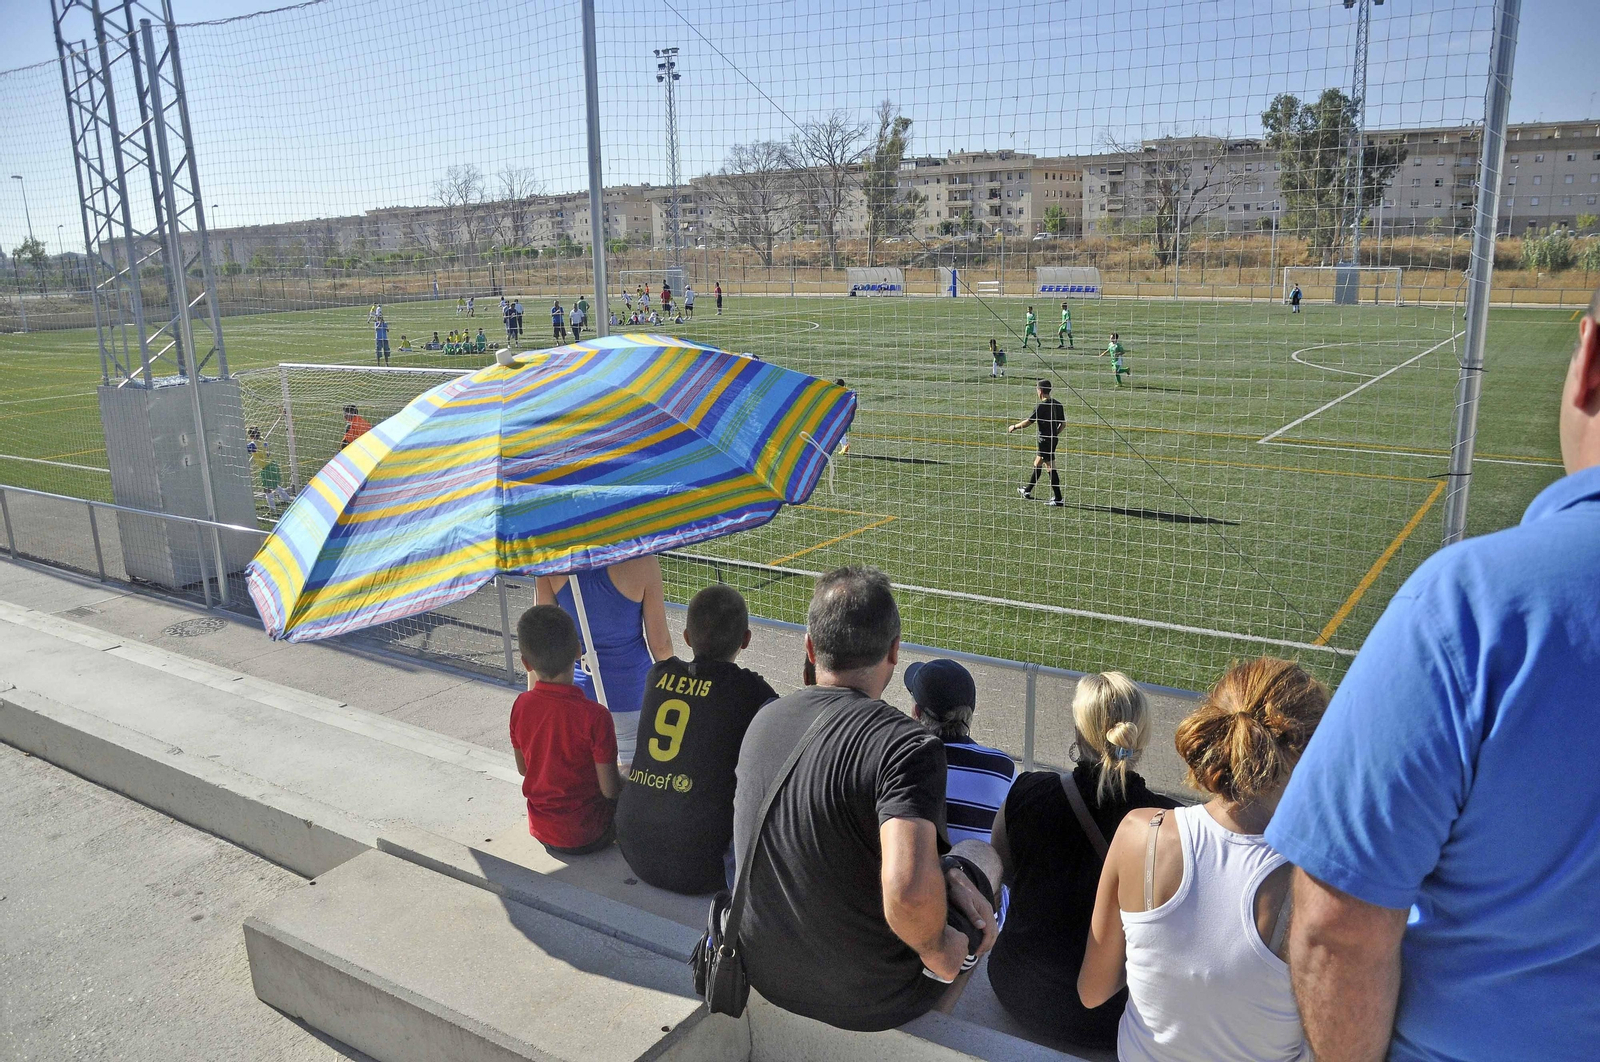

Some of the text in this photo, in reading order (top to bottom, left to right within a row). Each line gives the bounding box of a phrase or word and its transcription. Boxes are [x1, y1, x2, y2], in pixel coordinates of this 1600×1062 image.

[656, 673, 712, 697] ALEXIS
[648, 699, 691, 762] 9
[629, 769, 672, 790] unicef
